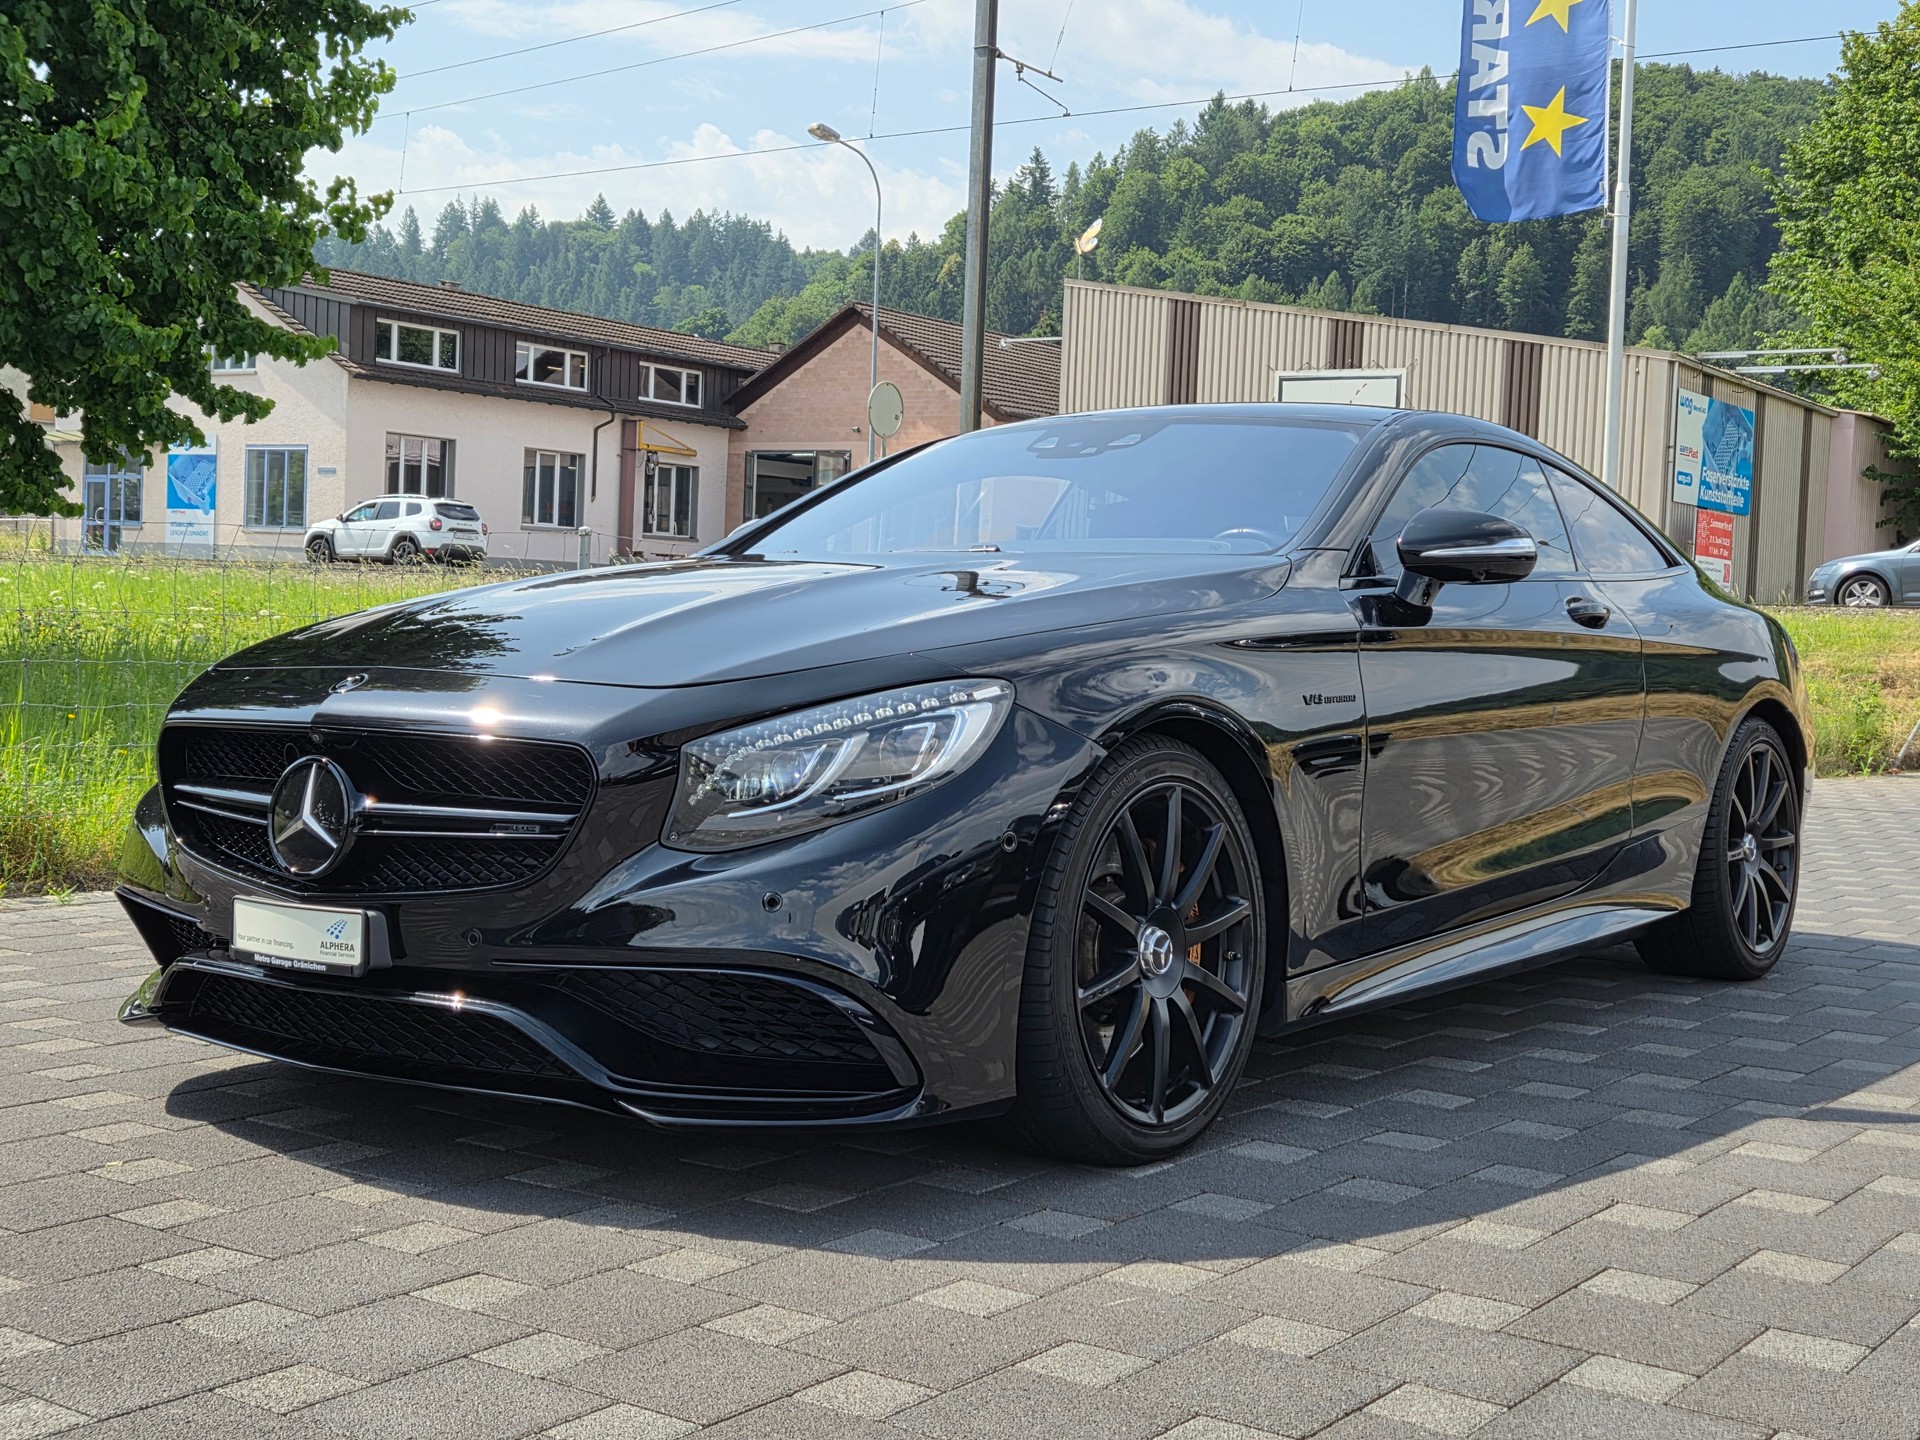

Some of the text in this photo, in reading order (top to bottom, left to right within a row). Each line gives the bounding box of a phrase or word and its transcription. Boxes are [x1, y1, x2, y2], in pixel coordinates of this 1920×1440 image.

[246, 935, 261, 943] partner
[320, 941, 355, 952] ALPHERA
[338, 951, 356, 959] Services
[254, 953, 327, 971] Metro Garage Gränichen
